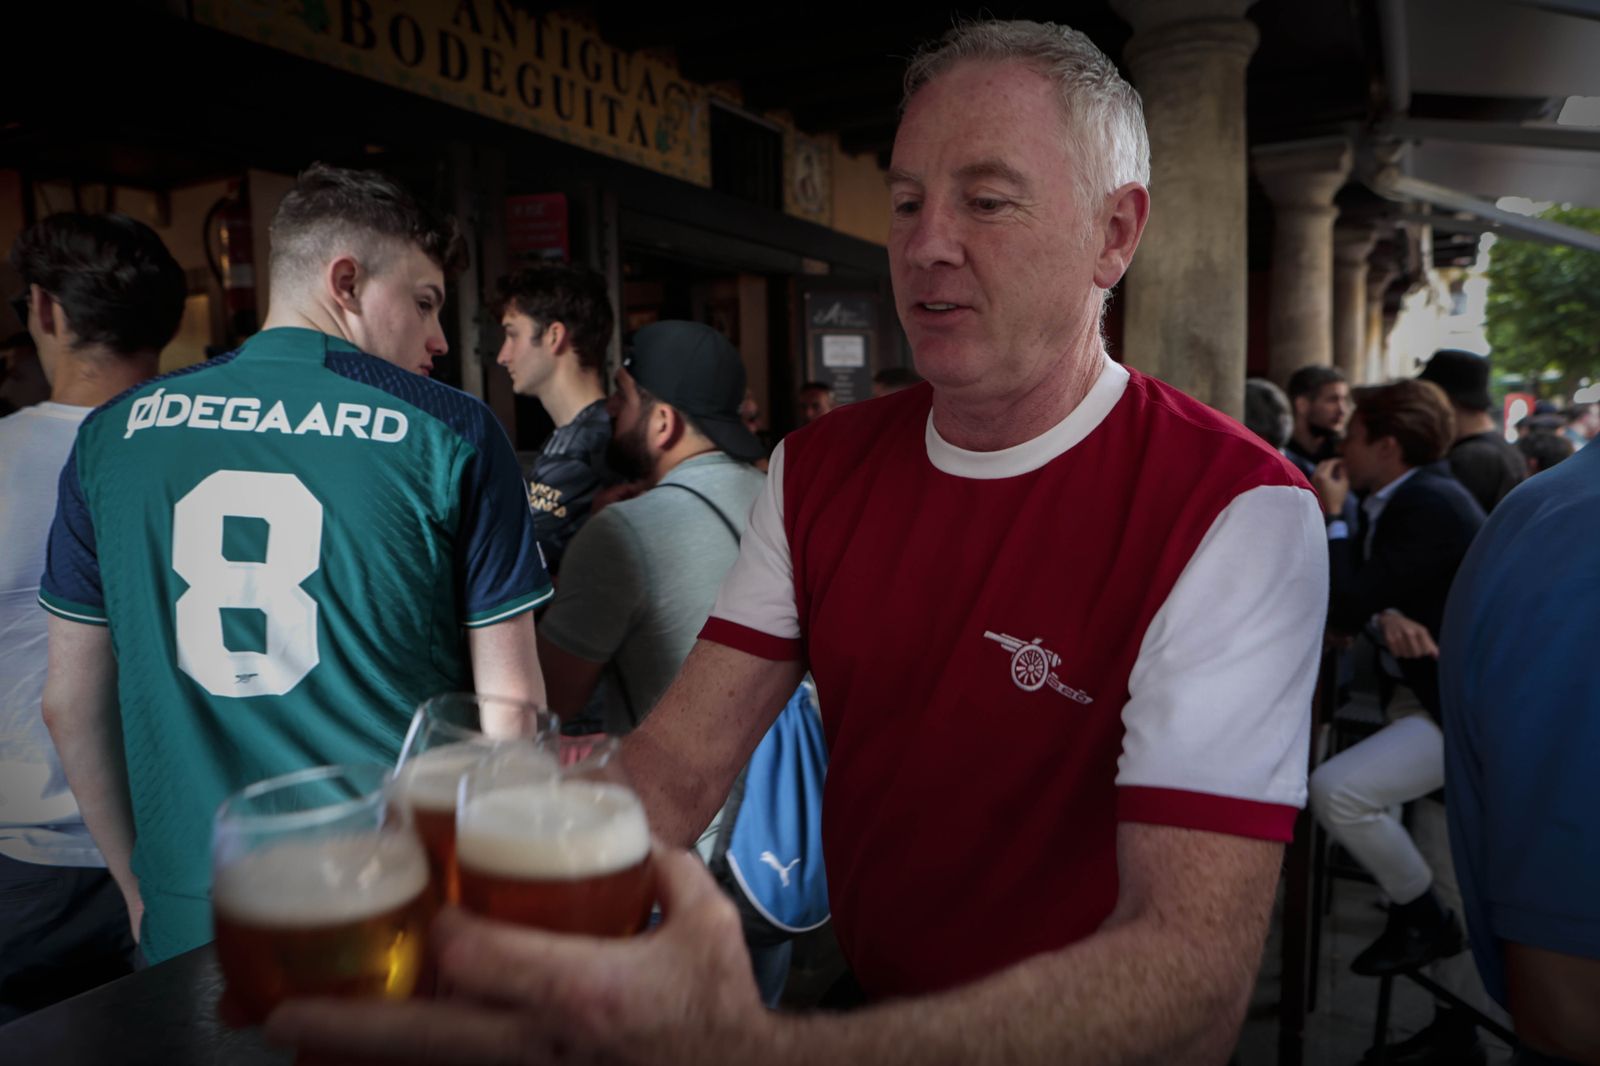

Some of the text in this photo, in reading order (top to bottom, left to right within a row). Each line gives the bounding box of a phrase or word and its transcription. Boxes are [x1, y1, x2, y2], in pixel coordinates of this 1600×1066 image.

[341, 0, 649, 147] BODEGUITA
[455, 0, 657, 105] ANTIGUA
[123, 388, 409, 443] ØDEGAARD
[172, 469, 323, 698] 8
